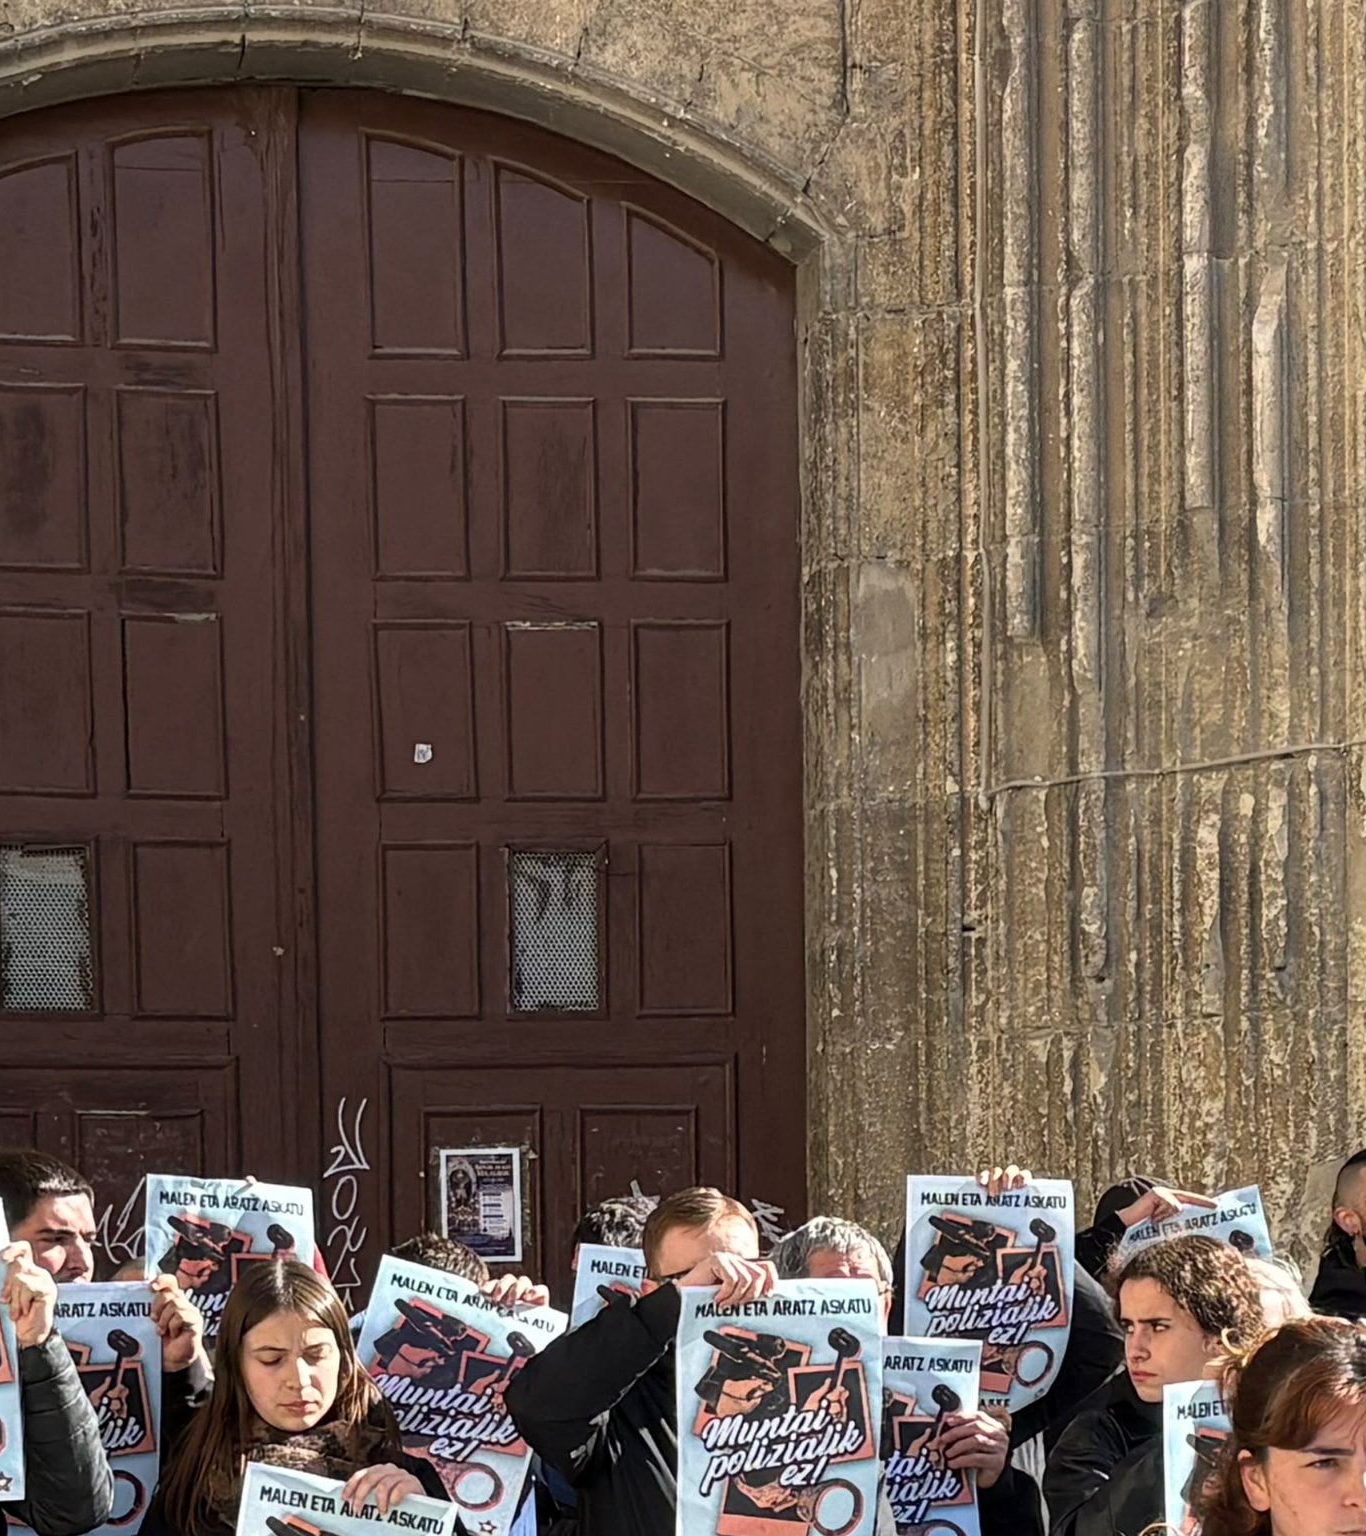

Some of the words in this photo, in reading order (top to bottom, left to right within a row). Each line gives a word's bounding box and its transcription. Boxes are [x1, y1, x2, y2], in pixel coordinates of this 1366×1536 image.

[921, 1192, 959, 1205] MALEN
[962, 1193, 982, 1205] ETA
[1025, 1195, 1066, 1208] ASKATU
[591, 1259, 630, 1277] MALEN
[633, 1266, 647, 1279] ET
[391, 1273, 434, 1295] MALEN
[924, 1276, 1030, 1308] Muntai
[100, 1302, 152, 1317] ASKATU
[744, 1301, 769, 1316] ETA
[773, 1299, 817, 1316] ARATZ
[821, 1298, 871, 1314] ASKATU
[989, 1322, 1028, 1343] ez!
[884, 1356, 924, 1370] ARATZ
[926, 1358, 974, 1373] ASKATU
[374, 1374, 491, 1414] Muntai
[395, 1408, 518, 1443] olizialik
[702, 1400, 830, 1447] Muntai
[430, 1438, 479, 1461] ez!
[701, 1421, 863, 1494] polizialik
[781, 1456, 827, 1484] ez!
[886, 1448, 931, 1481] tai
[887, 1468, 960, 1500] ialik
[260, 1485, 308, 1508] MALEN
[310, 1496, 335, 1515] ETA
[387, 1510, 444, 1535] ASKATU
